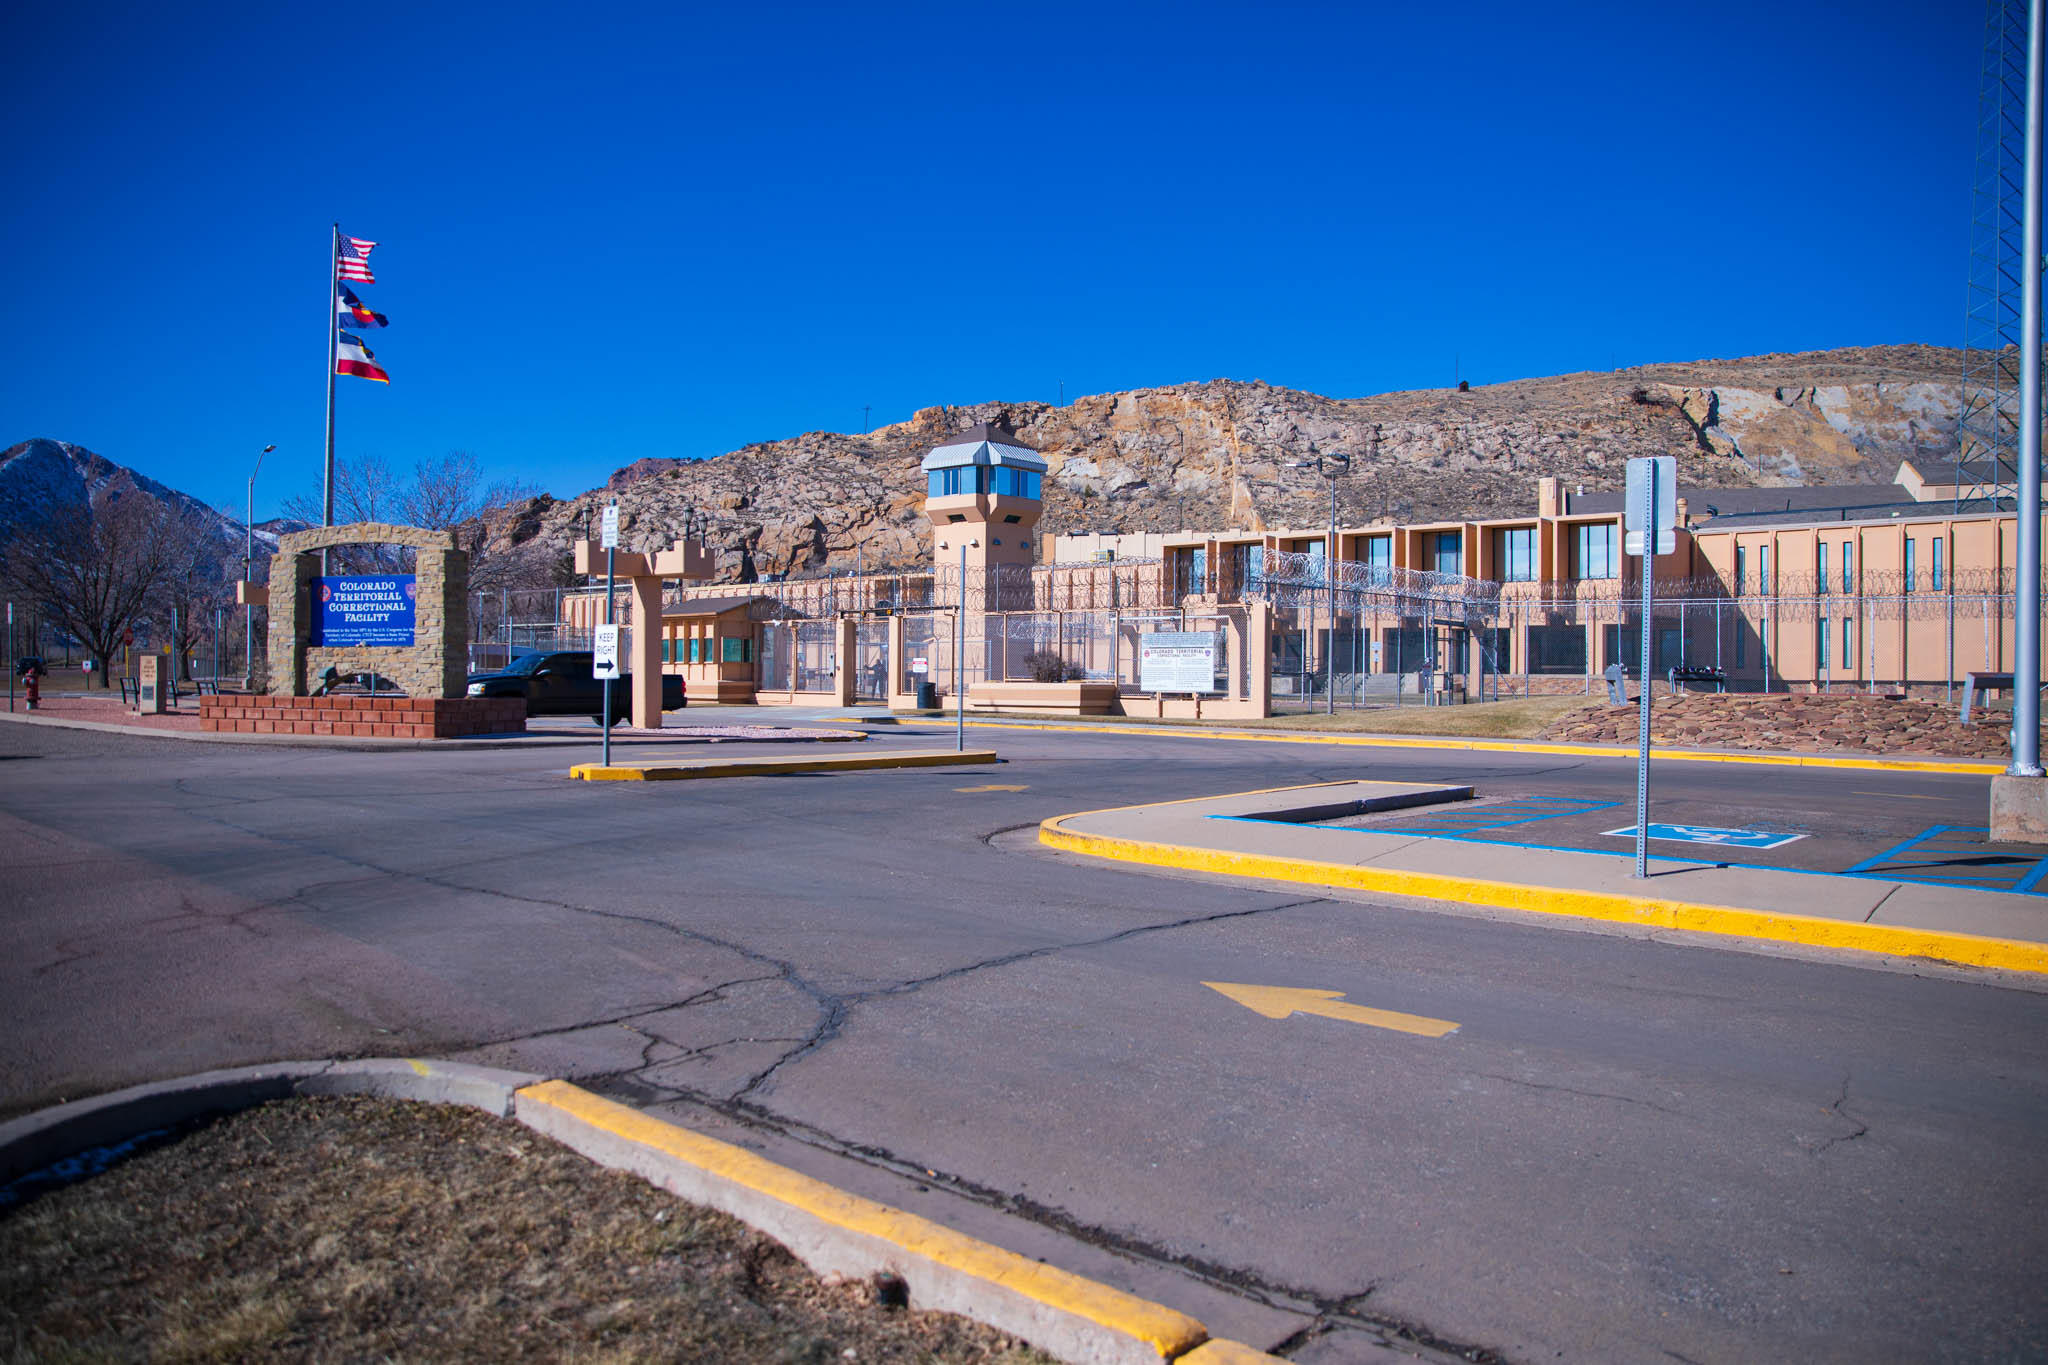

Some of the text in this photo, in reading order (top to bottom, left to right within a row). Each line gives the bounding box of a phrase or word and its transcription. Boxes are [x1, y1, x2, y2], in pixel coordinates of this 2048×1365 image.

[340, 581, 396, 591] COLORADO
[333, 592, 402, 602] TERRITORIAL
[328, 602, 406, 612] CORRECTIONAL
[345, 613, 390, 622] FACILITY
[599, 632, 614, 642] KEEP
[597, 645, 615, 655] RIGHT
